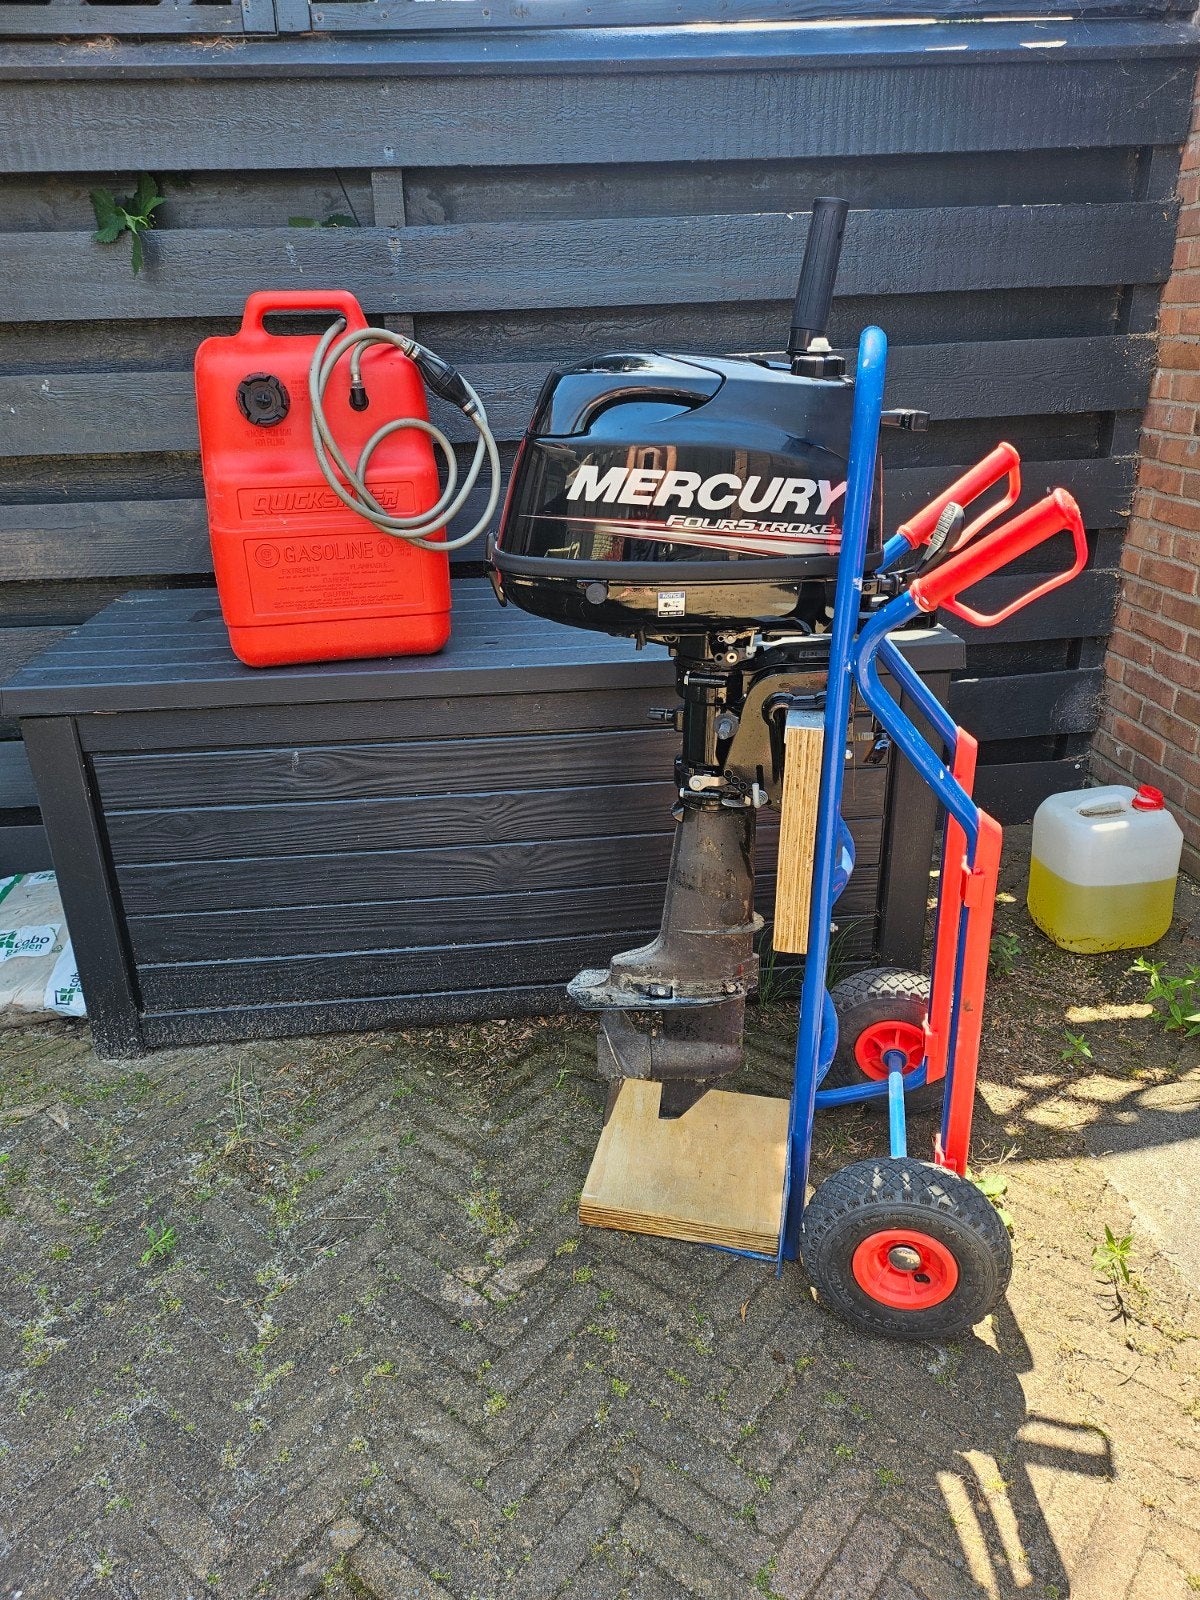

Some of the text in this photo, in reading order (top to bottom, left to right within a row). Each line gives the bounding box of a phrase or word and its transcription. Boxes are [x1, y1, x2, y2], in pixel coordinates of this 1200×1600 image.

[566, 465, 847, 516] MERCURY
[665, 514, 837, 535] FOURSTROKE
[284, 541, 374, 563] GASOLINE
[281, 565, 320, 575] EXTREMELY
[323, 590, 354, 599] CAUTION
